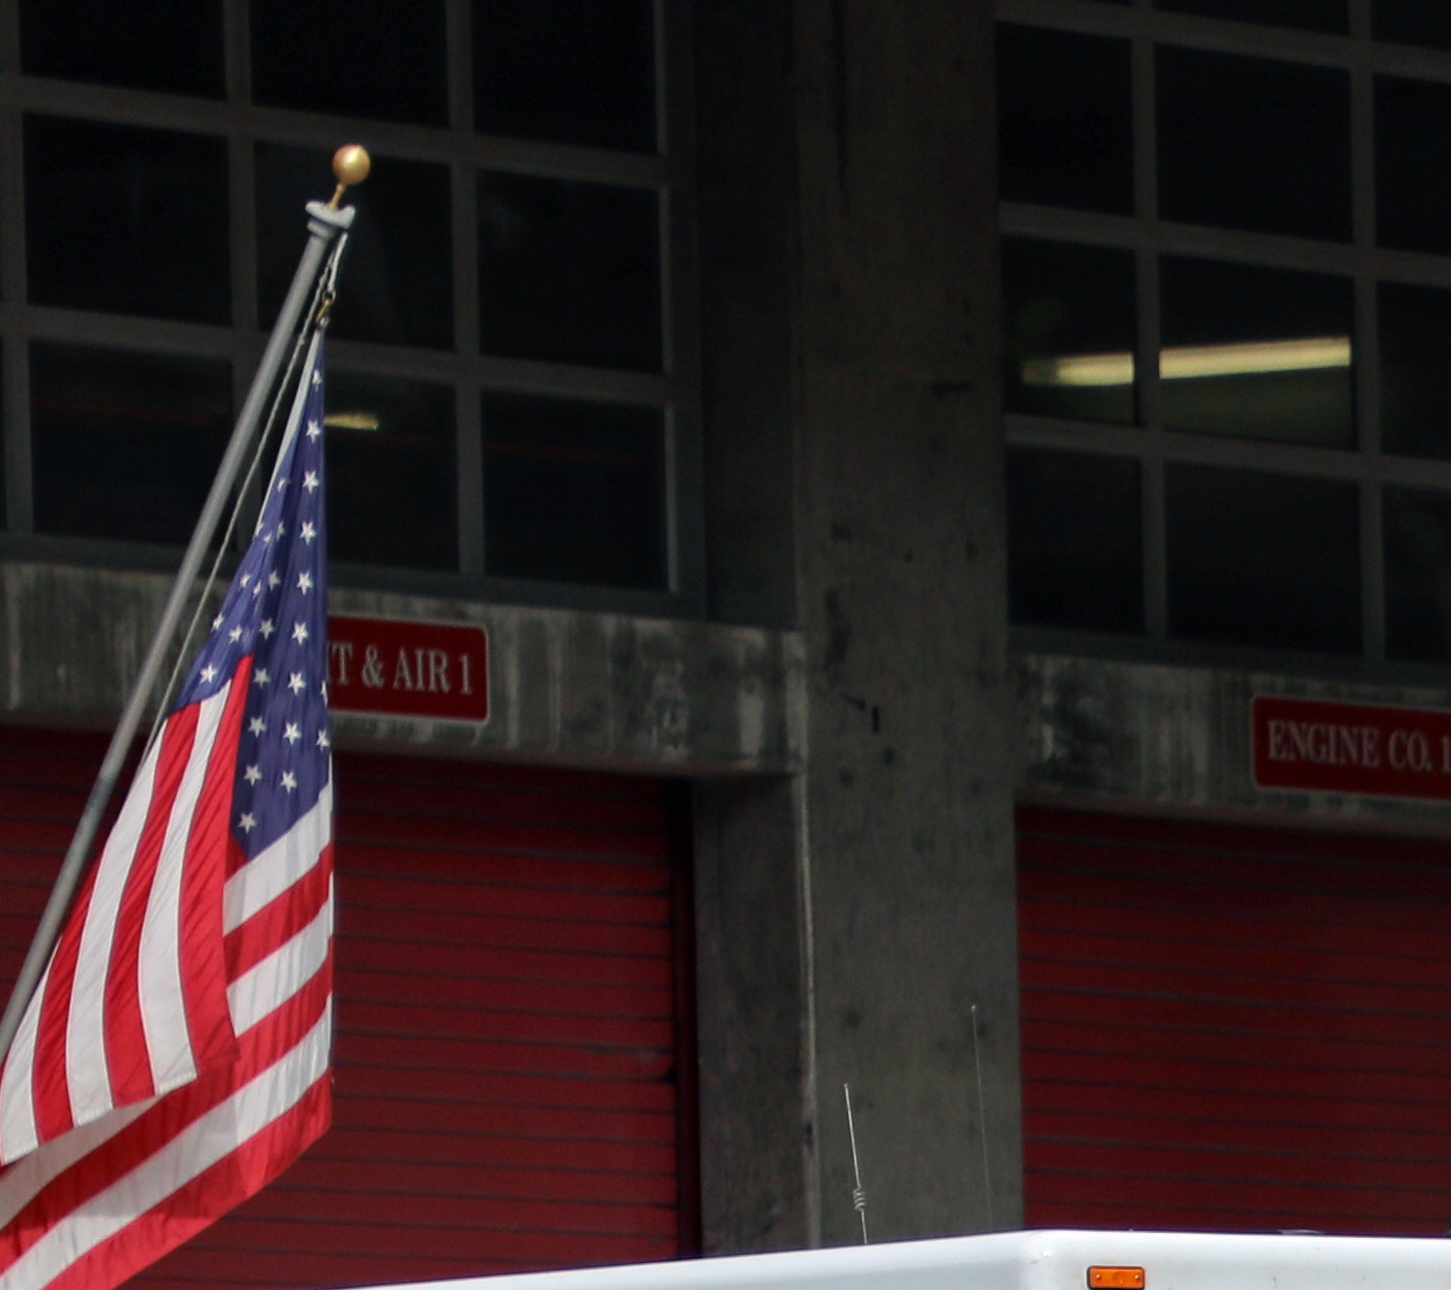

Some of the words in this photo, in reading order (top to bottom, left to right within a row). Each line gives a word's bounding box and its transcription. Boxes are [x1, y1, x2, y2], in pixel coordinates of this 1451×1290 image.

[360, 644, 384, 688] &
[392, 647, 450, 694] AIR
[459, 654, 473, 695] 1
[1267, 719, 1380, 769] ENGINE
[1387, 730, 1433, 774] CO.
